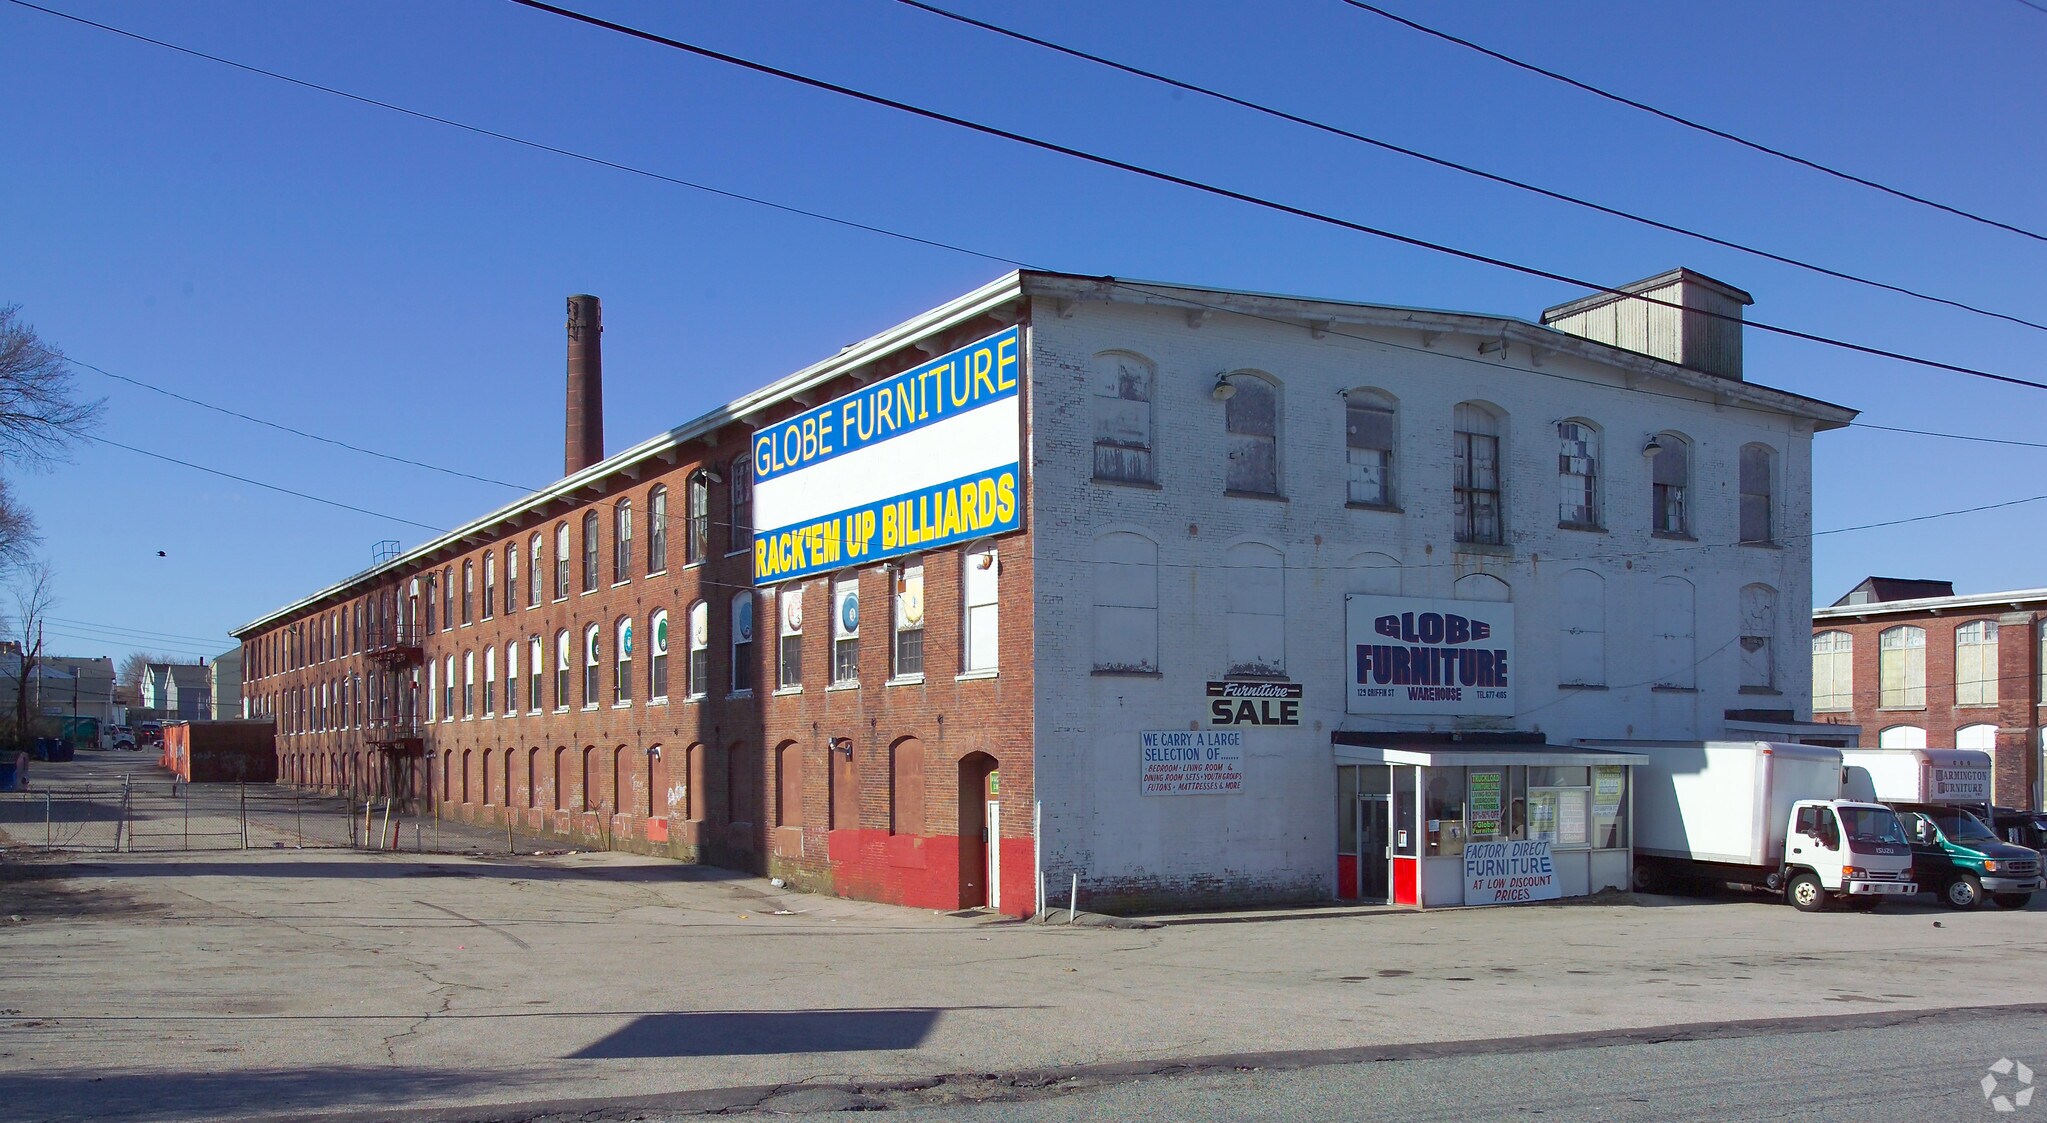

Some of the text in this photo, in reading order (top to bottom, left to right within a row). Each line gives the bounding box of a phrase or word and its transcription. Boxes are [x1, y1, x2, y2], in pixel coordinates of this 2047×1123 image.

[755, 336, 1016, 476] GLOBE FURNITURE
[755, 472, 1015, 578] RACK'EM UP BILLIARDS
[1374, 611, 1490, 644] GLOBE
[1356, 644, 1507, 687] FURNITURE
[1223, 683, 1288, 697] Furniture
[1388, 688, 1395, 697] ST
[1408, 686, 1462, 701] WAREHOUSE
[1212, 699, 1299, 725] SALE
[1143, 732, 1240, 746] WE CARRY A LARGE
[1144, 748, 1200, 761] SELECTION
[1148, 764, 1179, 772] BEDROOM
[1182, 764, 1202, 772] LIVING
[1204, 763, 1223, 771] ROOM
[1144, 774, 1163, 782] DINING
[1147, 783, 1172, 791] FUTONS
[1178, 782, 1218, 791] MATTRESSES
[1225, 781, 1241, 789] MORE
[1465, 841, 1549, 859] FACTORY DIRECT
[1466, 856, 1552, 877] FURNITURE
[1472, 875, 1552, 890] AT LOW DISCOUNT
[1494, 888, 1530, 902] PRICES
